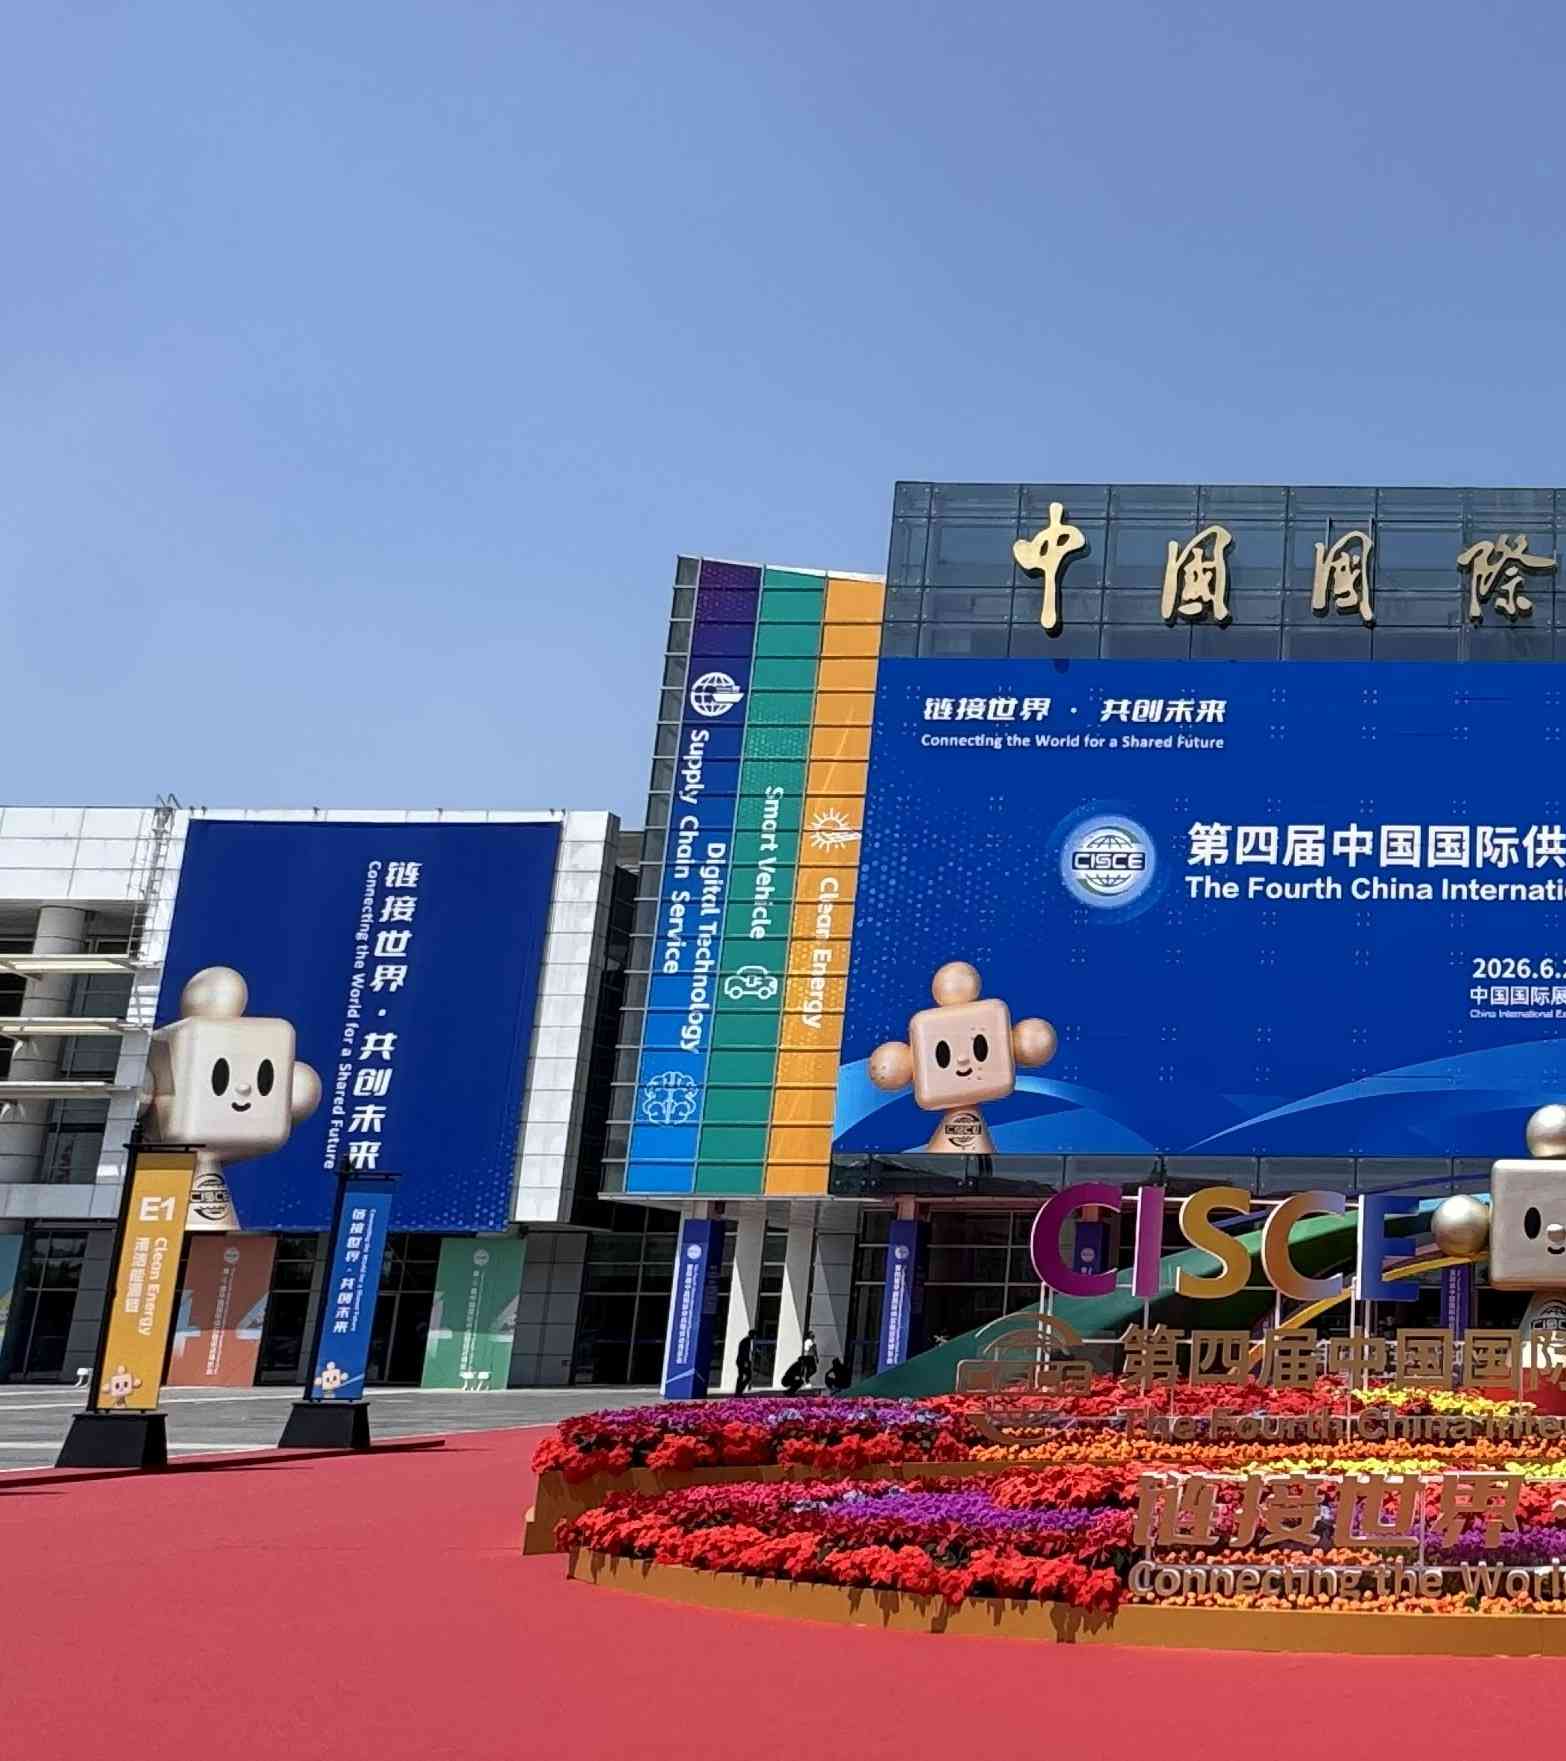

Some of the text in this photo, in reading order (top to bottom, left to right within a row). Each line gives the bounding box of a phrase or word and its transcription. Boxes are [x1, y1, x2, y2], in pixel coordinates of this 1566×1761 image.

[921, 733, 1224, 749] Connecting the World for a Shared Future
[663, 728, 710, 975] Supply Chain Service
[750, 785, 785, 940] Smart Vehicle
[1073, 853, 1144, 870] CISCE
[355, 861, 382, 942] Connecting
[1186, 876, 1240, 900] The
[1248, 876, 1343, 900] Fourth
[1351, 877, 1434, 901] China
[354, 944, 370, 969] the
[680, 842, 726, 1055] Digital Technology
[802, 876, 839, 1028] Clean Energy
[346, 973, 366, 1019] World
[341, 1023, 360, 1044] for
[332, 1063, 353, 1115] Shared
[323, 1119, 344, 1170] Future
[139, 1196, 177, 1222] E1
[1030, 1182, 1421, 1302] CISCE
[138, 1236, 169, 1336] Clean Energy
[1119, 1407, 1195, 1441] The
[1210, 1406, 1348, 1441] Fourth
[1357, 1406, 1473, 1440] China
[1129, 1560, 1362, 1602] Connecting
[1375, 1560, 1444, 1597] the
